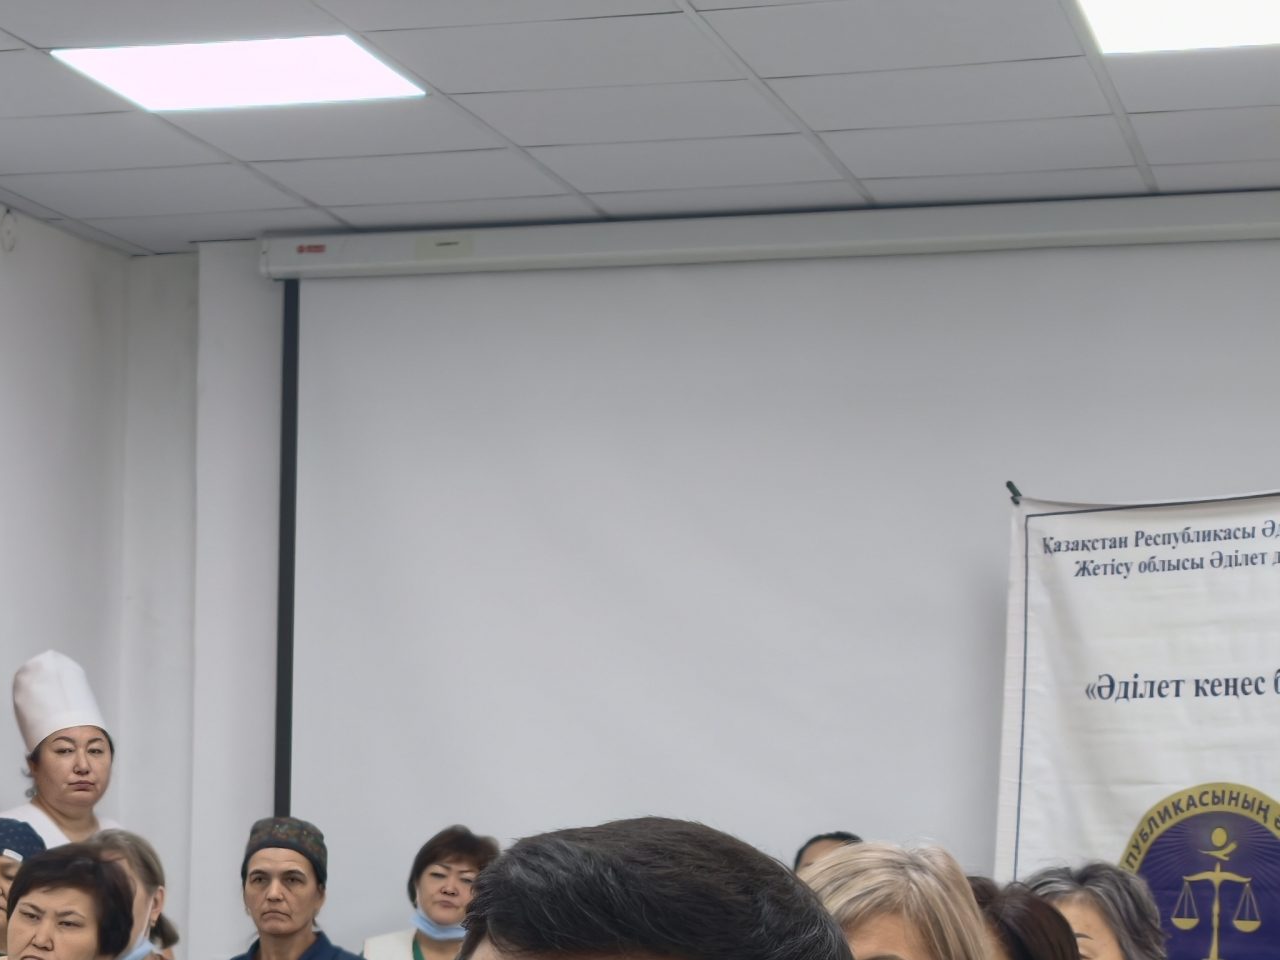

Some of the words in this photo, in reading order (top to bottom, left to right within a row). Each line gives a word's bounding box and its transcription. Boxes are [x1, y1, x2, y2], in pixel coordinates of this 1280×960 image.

[1042, 536, 1128, 555] Қазақстан
[1134, 525, 1256, 549] Республикасы
[1262, 520, 1280, 538] Ә
[1074, 560, 1133, 579] Жетісу
[1138, 553, 1205, 573] облысы
[1209, 550, 1267, 569] Әділет
[1084, 672, 1185, 702] «Әділет
[1194, 674, 1266, 700] кеңес
[1124, 789, 1270, 869] ПУБЛИКАСЫНЫҢ
